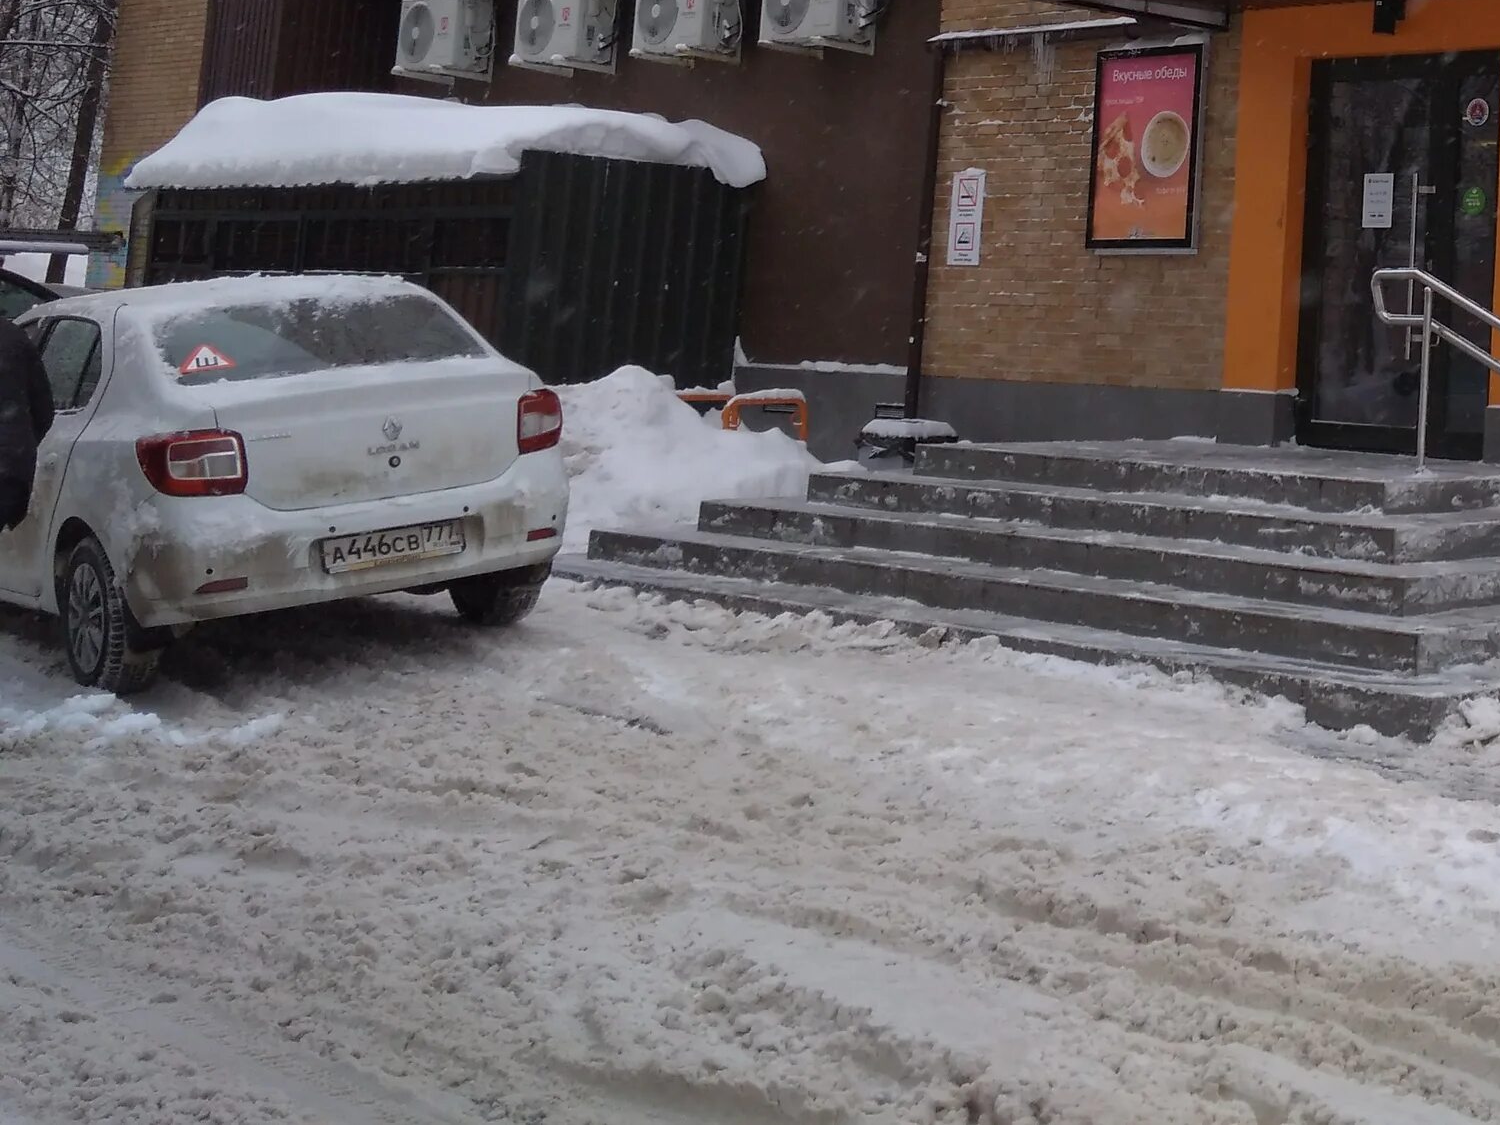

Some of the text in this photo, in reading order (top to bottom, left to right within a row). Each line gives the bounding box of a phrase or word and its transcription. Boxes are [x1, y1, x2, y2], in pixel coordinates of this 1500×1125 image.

[1112, 65, 1188, 85] Вкусные обеды
[195, 356, 218, 367] Ш
